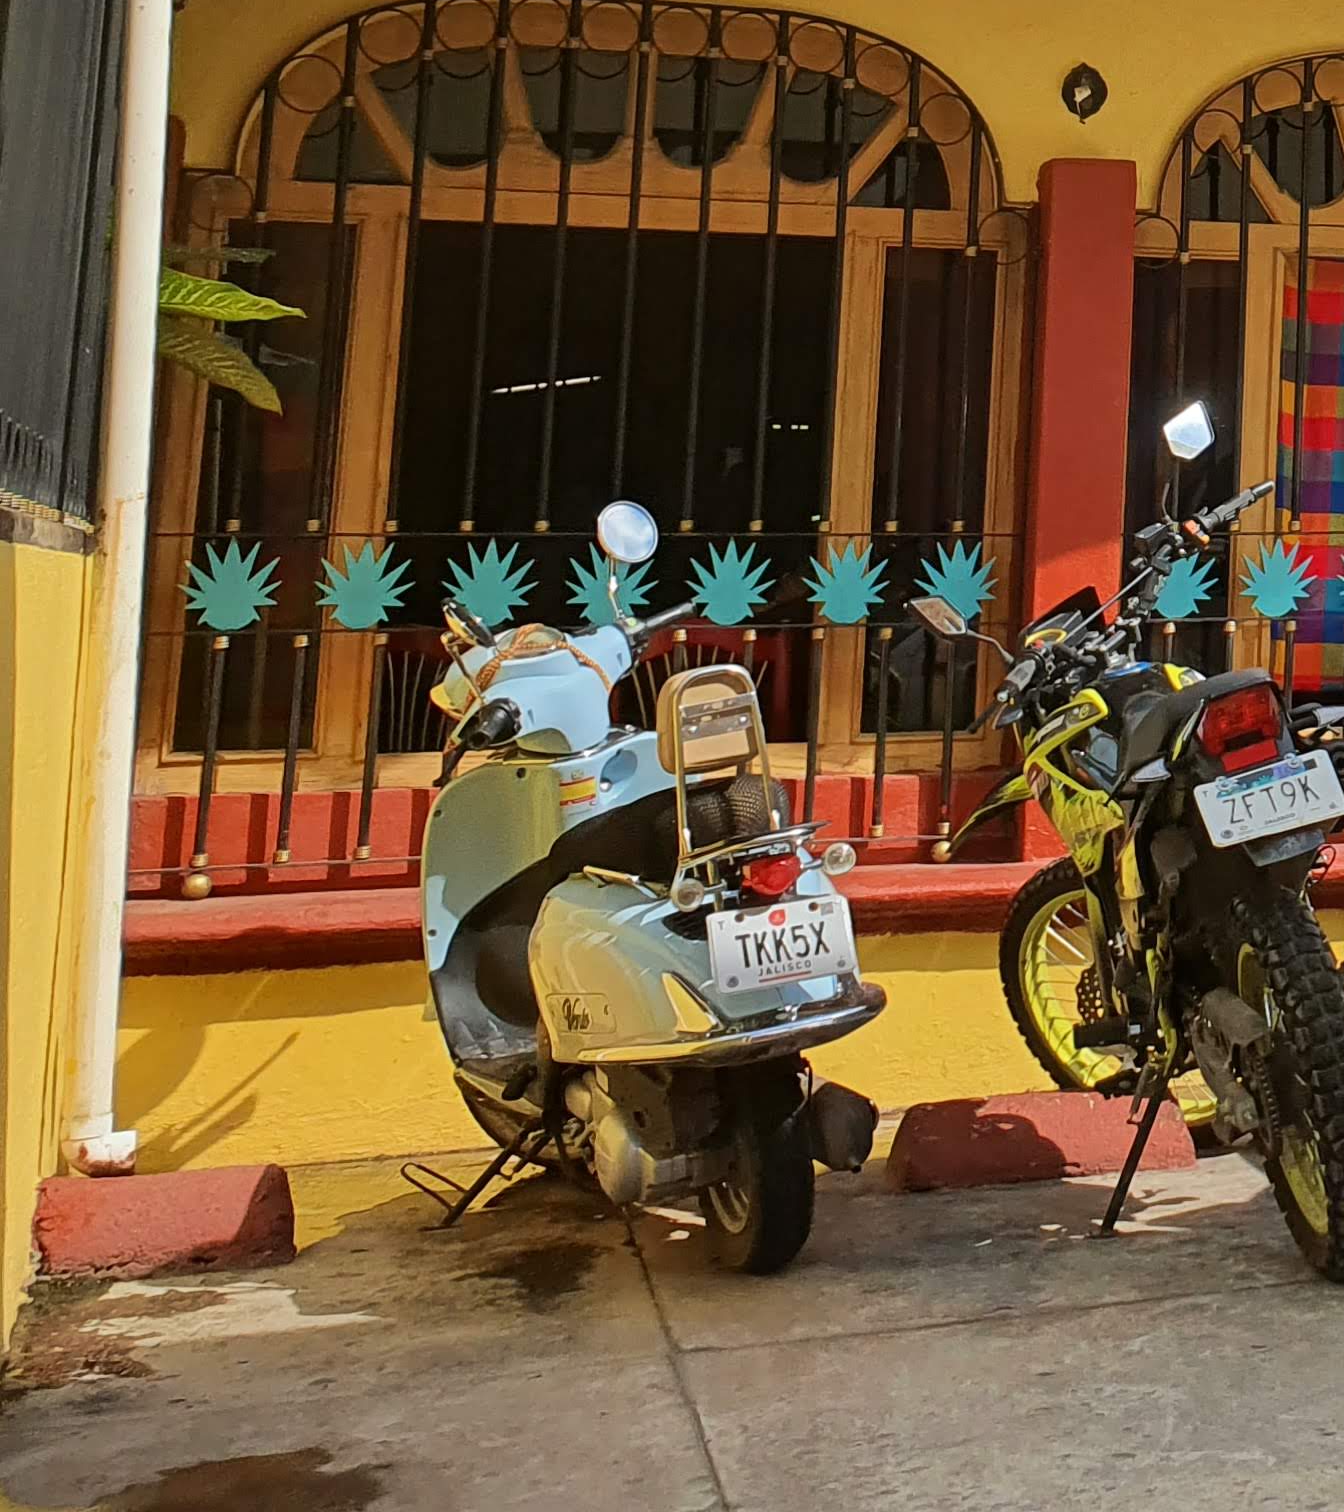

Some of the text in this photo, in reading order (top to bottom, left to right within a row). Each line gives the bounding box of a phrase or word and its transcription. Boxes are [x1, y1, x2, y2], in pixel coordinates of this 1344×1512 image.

[1222, 775, 1321, 825] ZFT9K
[734, 921, 831, 969] TKK5X
[757, 959, 812, 977] JALISCO
